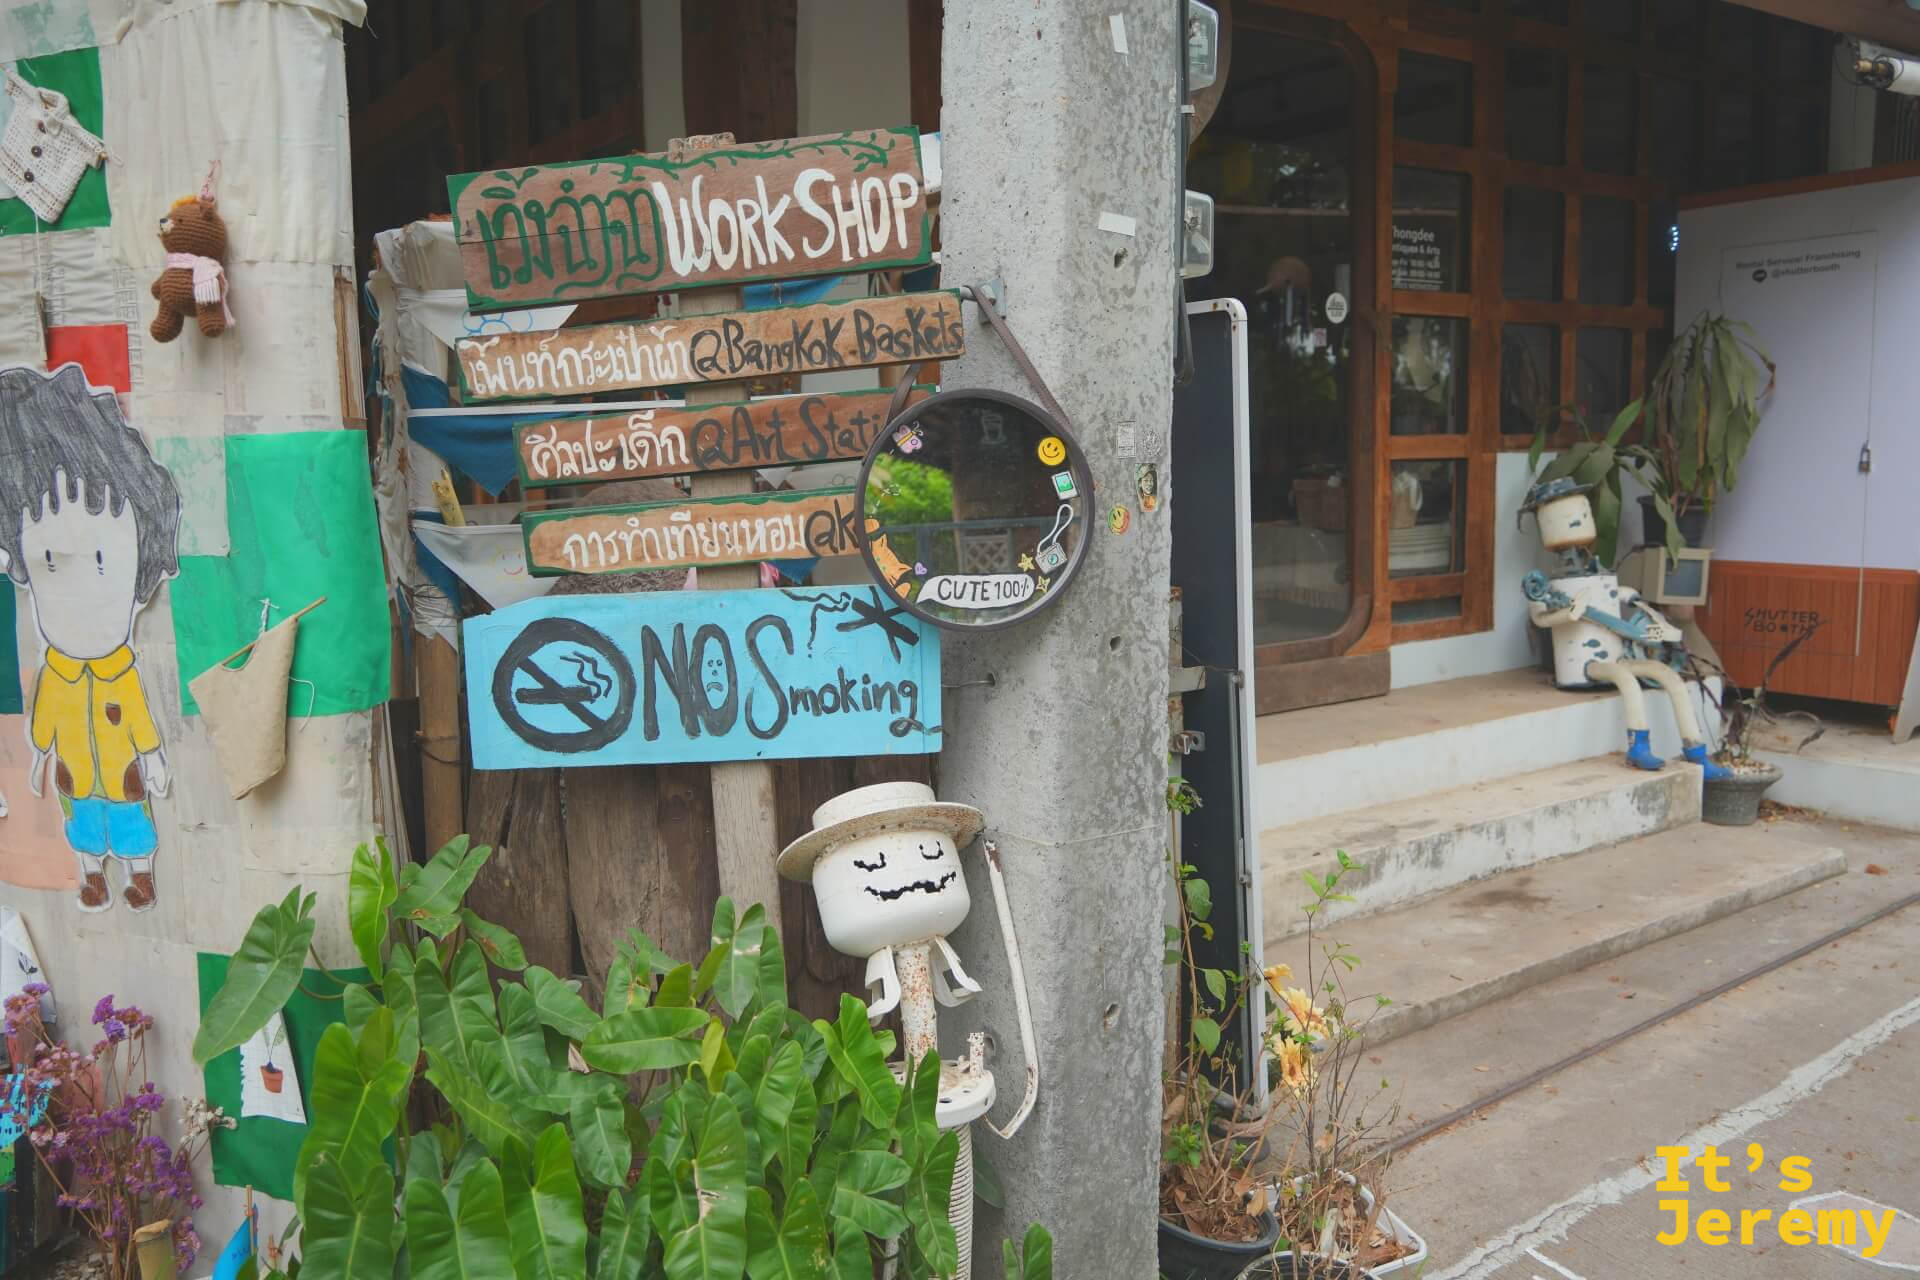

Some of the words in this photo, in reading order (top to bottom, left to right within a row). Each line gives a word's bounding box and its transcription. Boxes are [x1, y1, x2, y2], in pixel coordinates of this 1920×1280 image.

[1392, 224, 1435, 243] hongdee
[691, 406, 796, 471] @Art
[800, 397, 881, 460] Stati
[937, 578, 991, 601] CUTE
[641, 623, 738, 741] NO
[744, 614, 942, 741] Smoking
